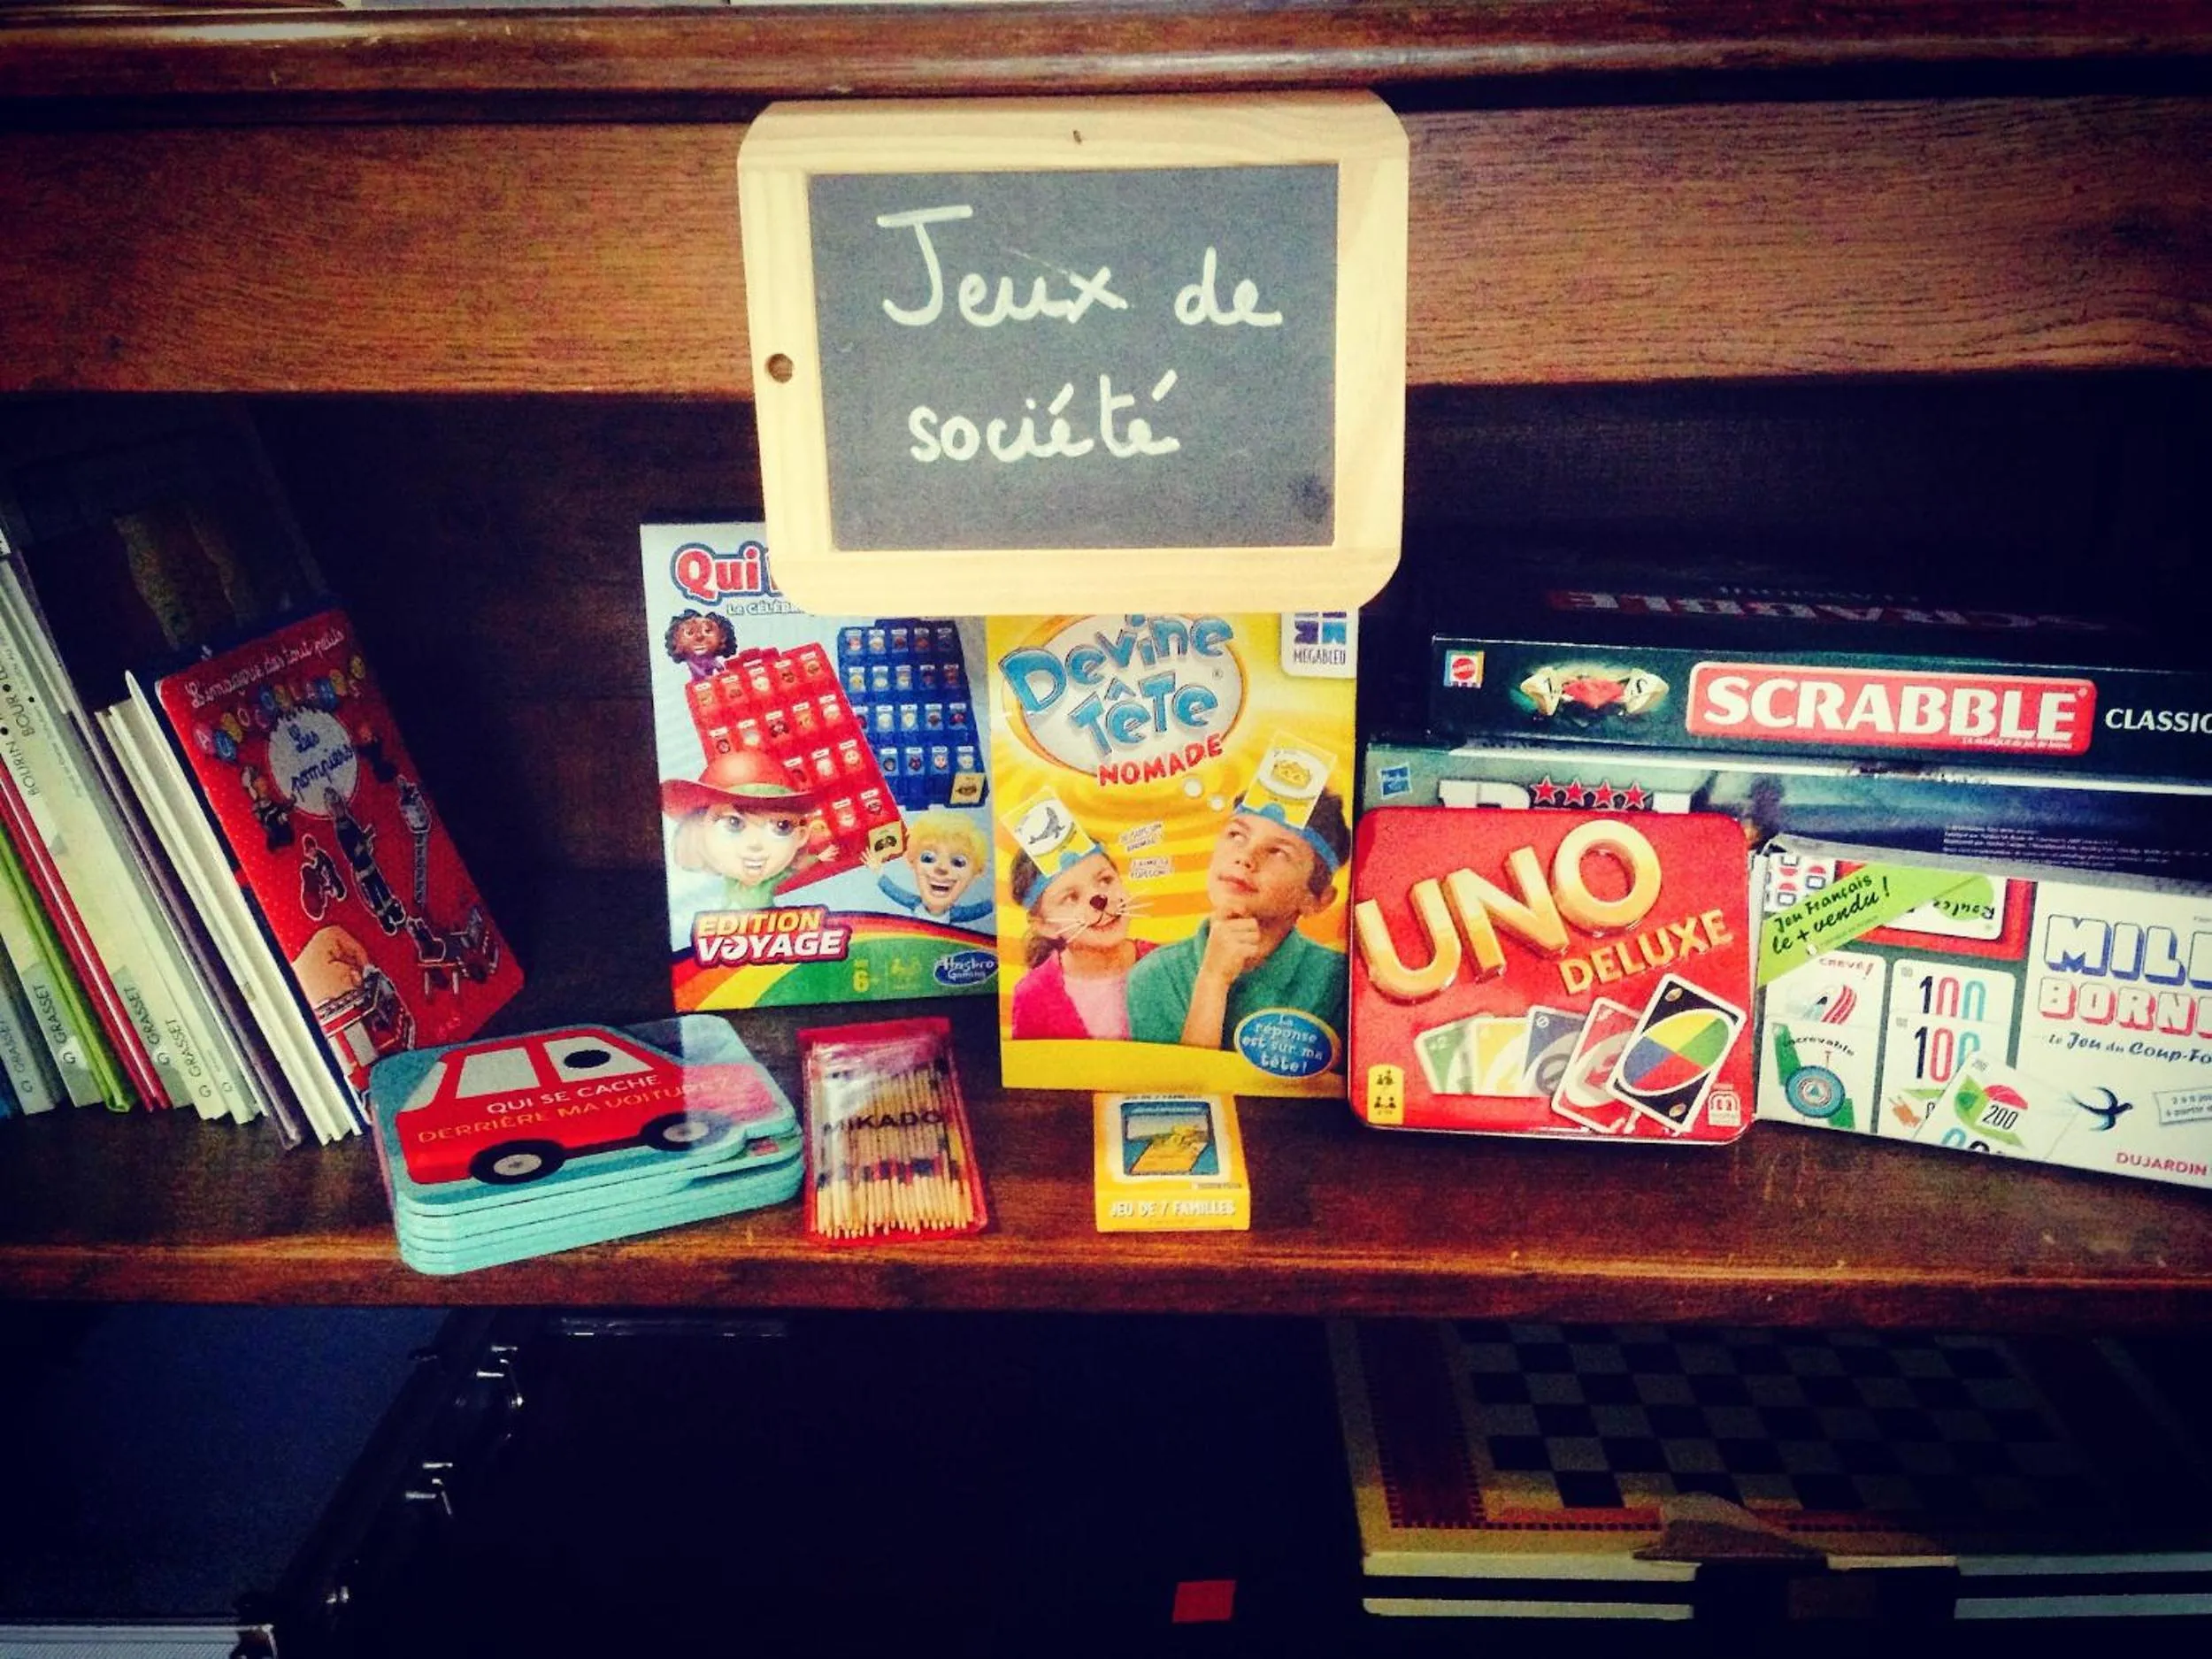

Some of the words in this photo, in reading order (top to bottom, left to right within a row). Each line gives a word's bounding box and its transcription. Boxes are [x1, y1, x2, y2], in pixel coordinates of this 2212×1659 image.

[876, 204, 1128, 327] Jeux
[1174, 246, 1284, 326] de
[908, 369, 1180, 463] société
[673, 544, 763, 602] Qui
[998, 615, 1233, 711] Devine
[1294, 649, 1346, 664] MEGABLEU
[1704, 677, 2076, 741] SCRABBLE
[1098, 733, 1223, 786] NOMADE
[698, 912, 822, 937] EDITION
[1355, 819, 1662, 1004] UNO
[1774, 911, 1802, 933] Jeu
[1805, 874, 1872, 916] Français
[697, 930, 845, 962] VOYAGE
[1558, 910, 1733, 995] DELUXE
[1772, 933, 1793, 954] le
[33, 984, 67, 1044] GRASSET
[124, 986, 160, 1045] GRASSET
[2067, 1032, 2101, 1049] Jeu
[165, 1019, 202, 1077] GRASSET
[487, 1097, 534, 1114] QUI
[541, 1090, 567, 1104] SE
[576, 1075, 659, 1099] CACHE
[557, 1102, 603, 1118] MA
[1982, 1104, 2019, 1130] 200
[2116, 1152, 2208, 1176] DUJARDIN
